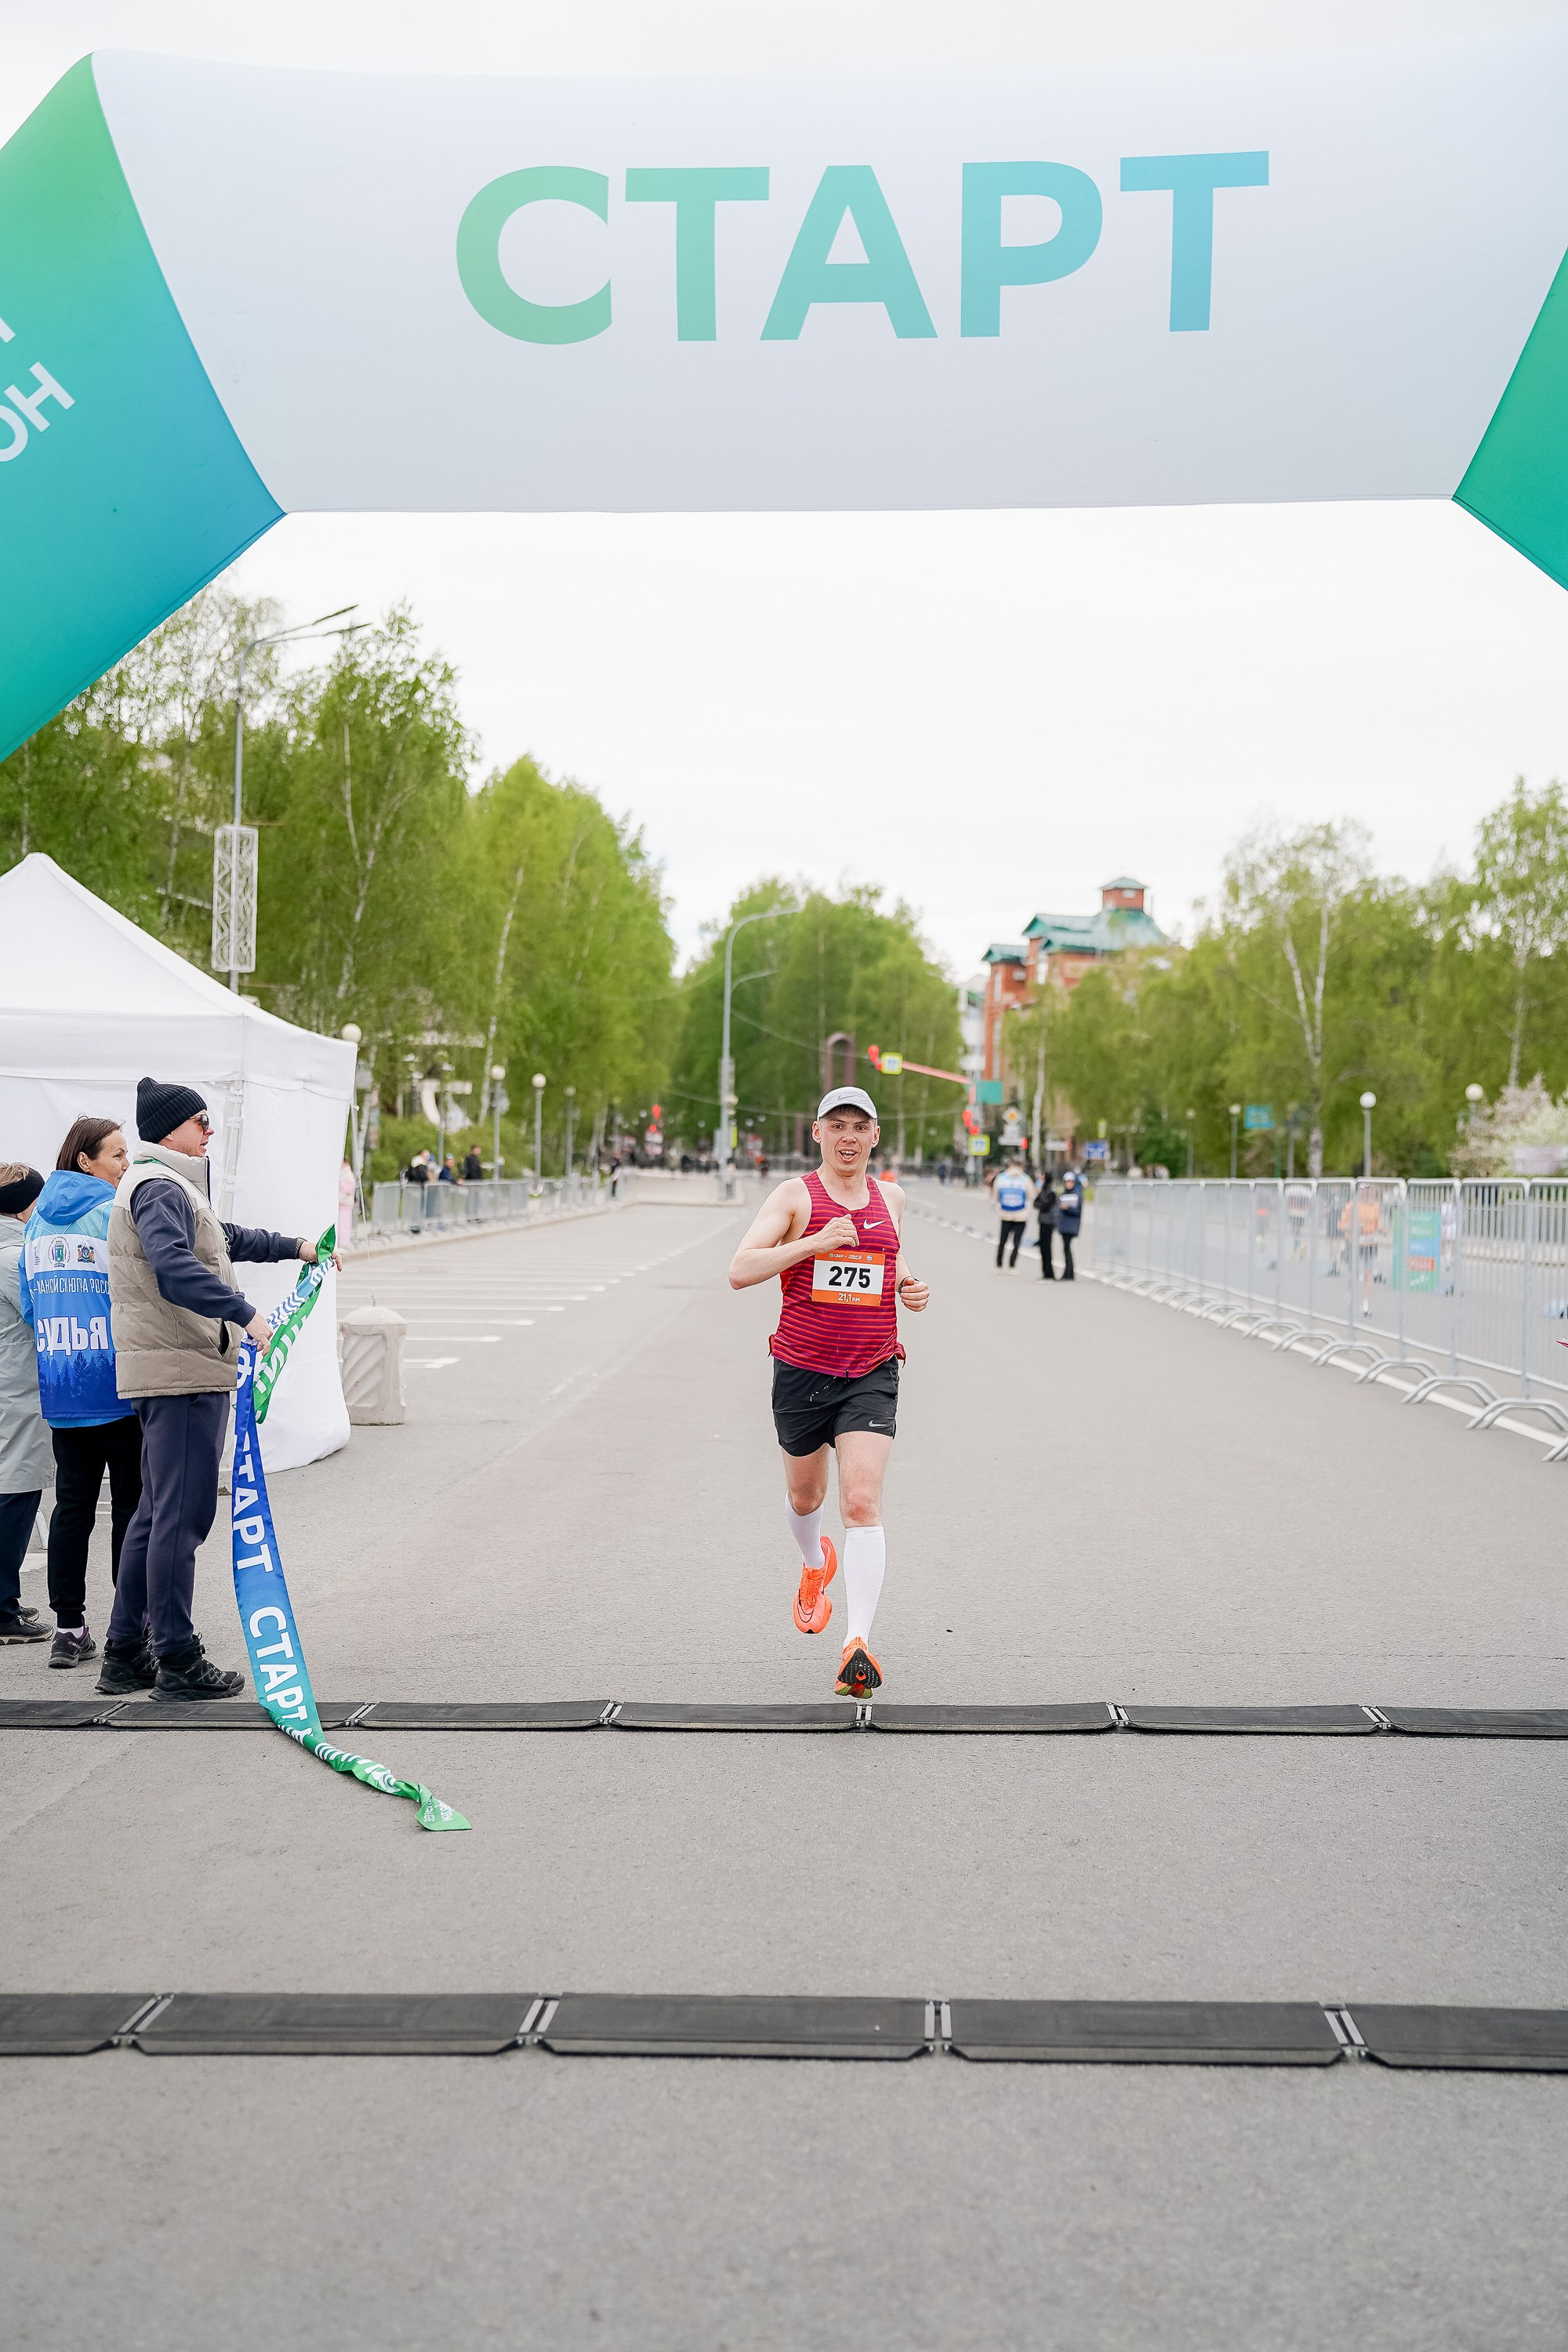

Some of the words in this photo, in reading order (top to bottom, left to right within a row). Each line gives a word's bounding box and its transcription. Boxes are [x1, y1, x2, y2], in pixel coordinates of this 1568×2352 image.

[456, 150, 1269, 345] СТАРТ
[829, 1265, 871, 1288] 275
[249, 1605, 308, 1722] СТАРТ
